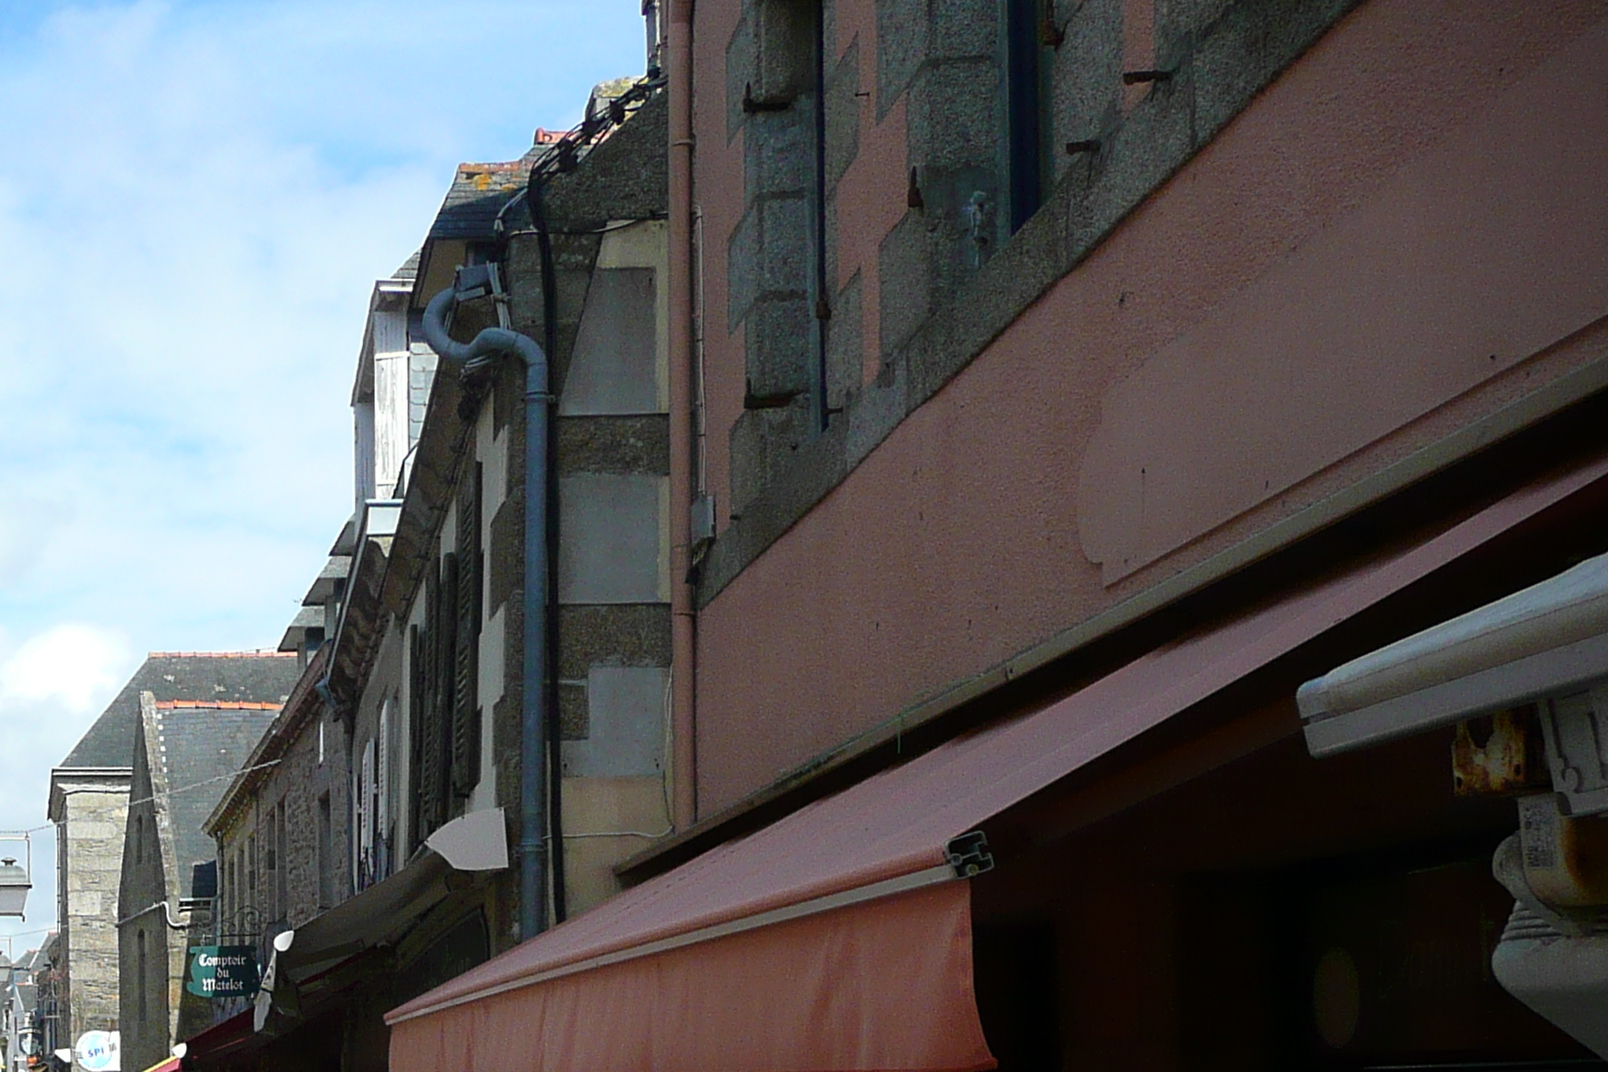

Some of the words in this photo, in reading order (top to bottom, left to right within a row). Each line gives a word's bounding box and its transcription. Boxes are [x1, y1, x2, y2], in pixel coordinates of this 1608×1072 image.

[198, 953, 247, 968] Comptoir
[217, 967, 230, 978] du
[202, 978, 244, 991] Matelot
